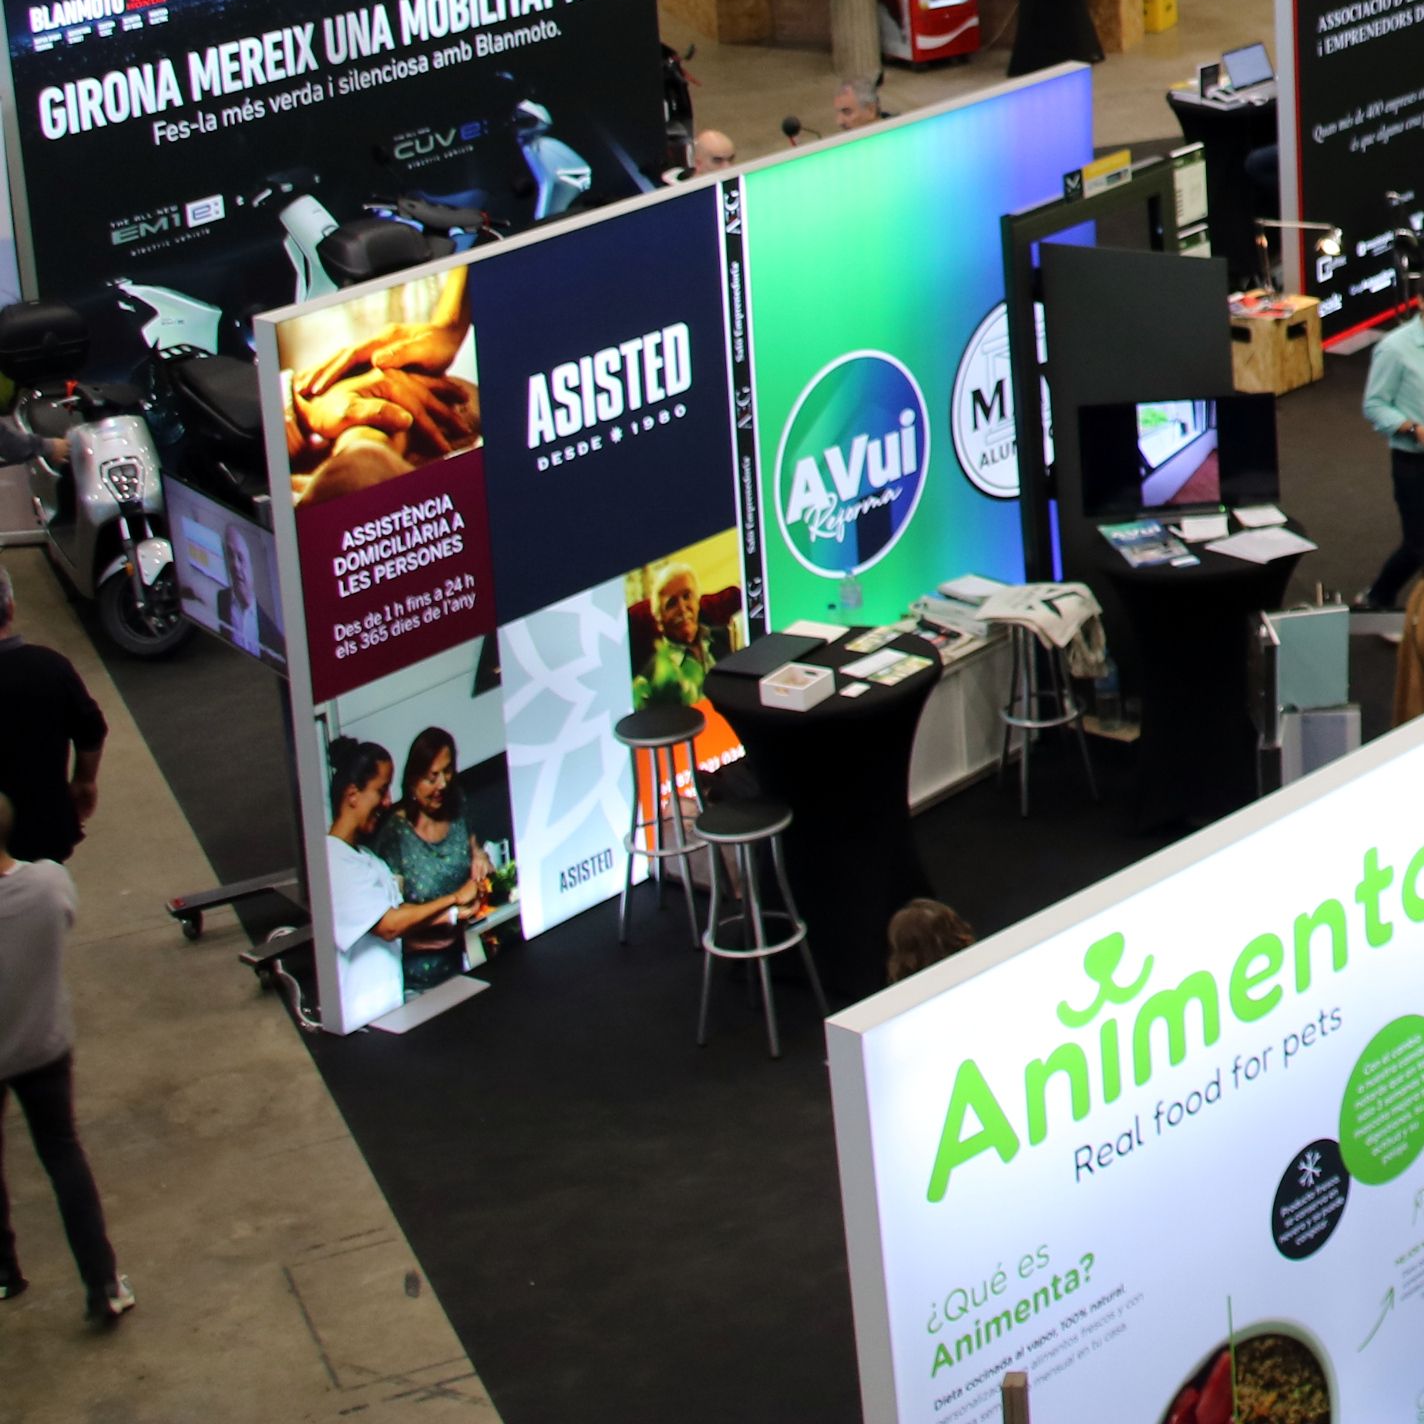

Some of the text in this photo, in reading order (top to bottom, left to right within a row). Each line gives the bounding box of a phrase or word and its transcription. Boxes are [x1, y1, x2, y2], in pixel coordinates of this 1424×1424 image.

[1326, 11, 1414, 55] EMPRENEDORS
[38, 57, 184, 142] GIRONA
[186, 21, 320, 103] MEREIX
[322, 3, 396, 65] UNA
[152, 19, 563, 147] Fes-la més verda i silenciosa amb Blanmoto.
[111, 213, 181, 246] EM1
[526, 321, 693, 450] ASISTED
[537, 403, 688, 472] DESDE 1980
[786, 408, 918, 526] AVui
[332, 511, 466, 579] DOMICILIÀRIA A
[341, 492, 454, 553] ASSISTÈNCIA
[806, 485, 904, 543] Reforma
[338, 535, 465, 598] LES PERSONES
[333, 614, 363, 644] Des
[364, 606, 385, 632] de
[394, 598, 405, 621] h
[406, 589, 431, 615] fins
[433, 591, 443, 606] a
[444, 577, 463, 601] 24
[464, 573, 475, 592] h
[335, 590, 477, 660] els 365 dies de l'any
[558, 847, 614, 894] ASISTED
[1073, 1005, 1345, 1184] Real food for pets
[926, 1244, 1051, 1335] ¿Qué es
[930, 1252, 1096, 1379] Animenta?
[933, 1387, 964, 1412] Dieta
[965, 1355, 1013, 1392] cocinada
[1014, 1346, 1025, 1361] al
